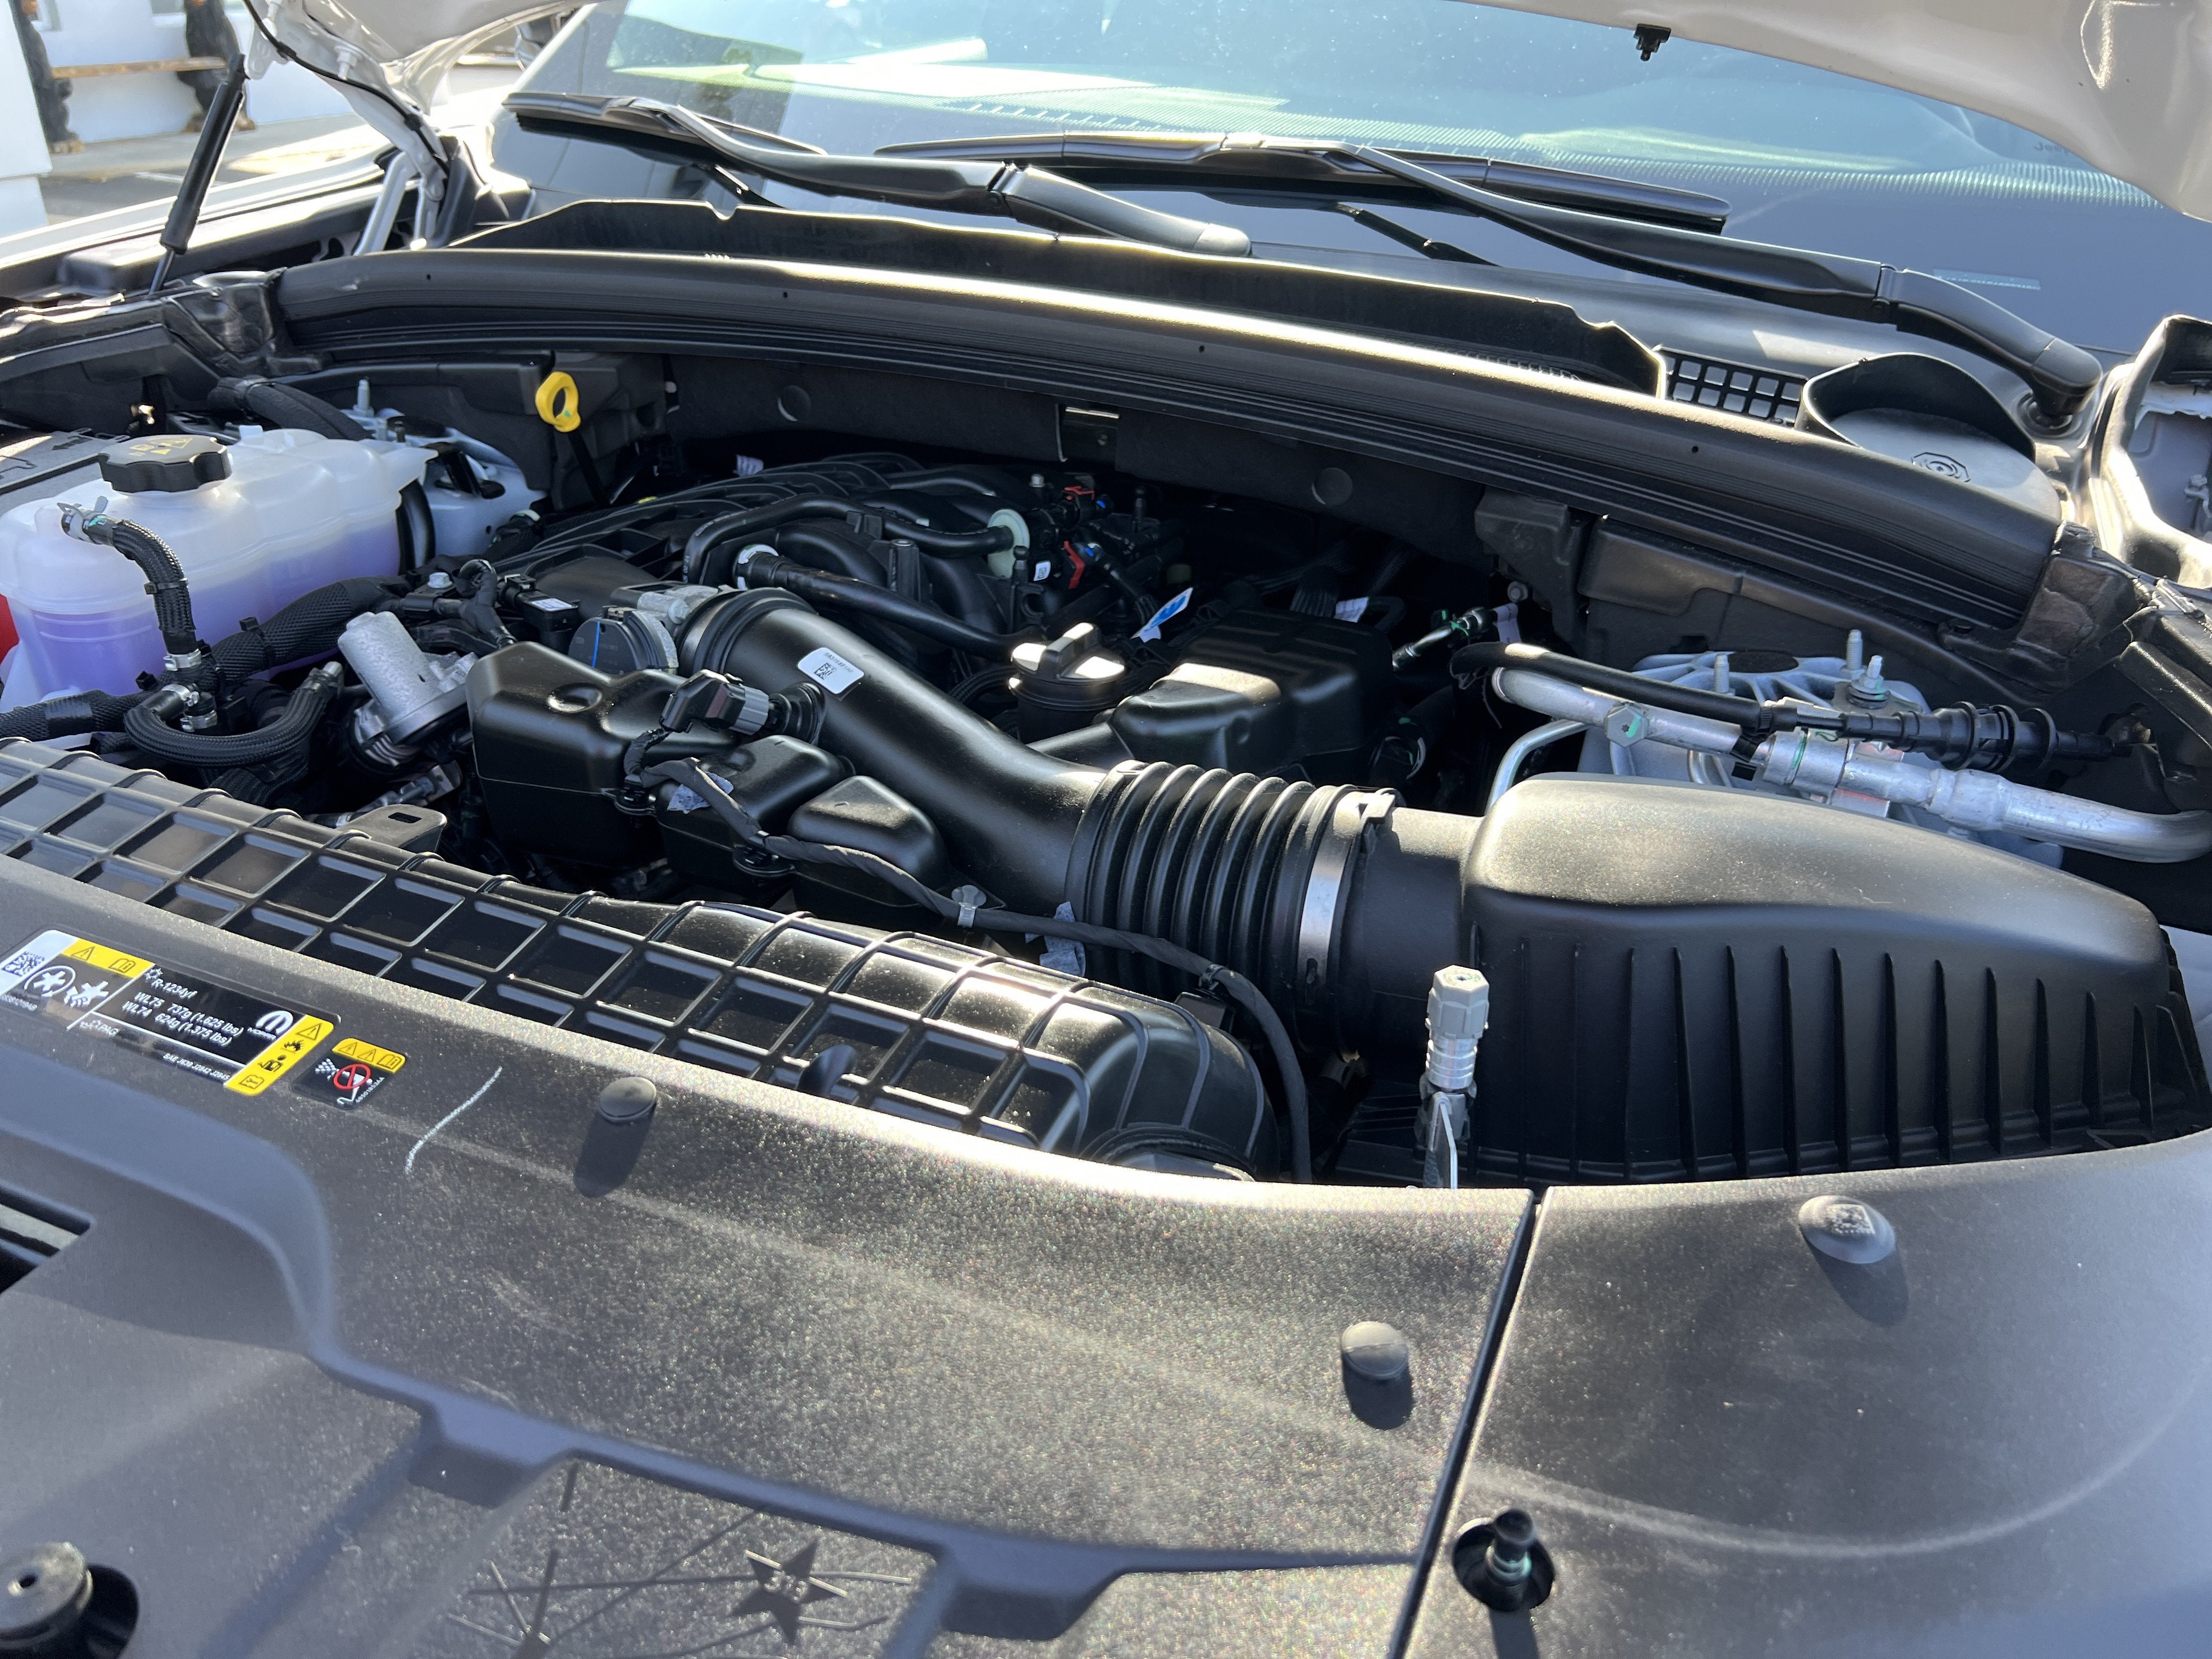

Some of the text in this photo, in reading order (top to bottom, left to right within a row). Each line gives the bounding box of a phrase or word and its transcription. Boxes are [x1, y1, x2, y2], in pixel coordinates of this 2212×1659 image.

[151, 978, 198, 1000] R-1234yf
[134, 991, 244, 1037] WL75 737g (1.625 lbs)
[98, 1024, 120, 1037] PAG
[122, 1001, 233, 1047] WL74 624g (1.375 lbs)
[247, 1027, 276, 1041] MOPAR
[163, 1053, 179, 1062] SAE
